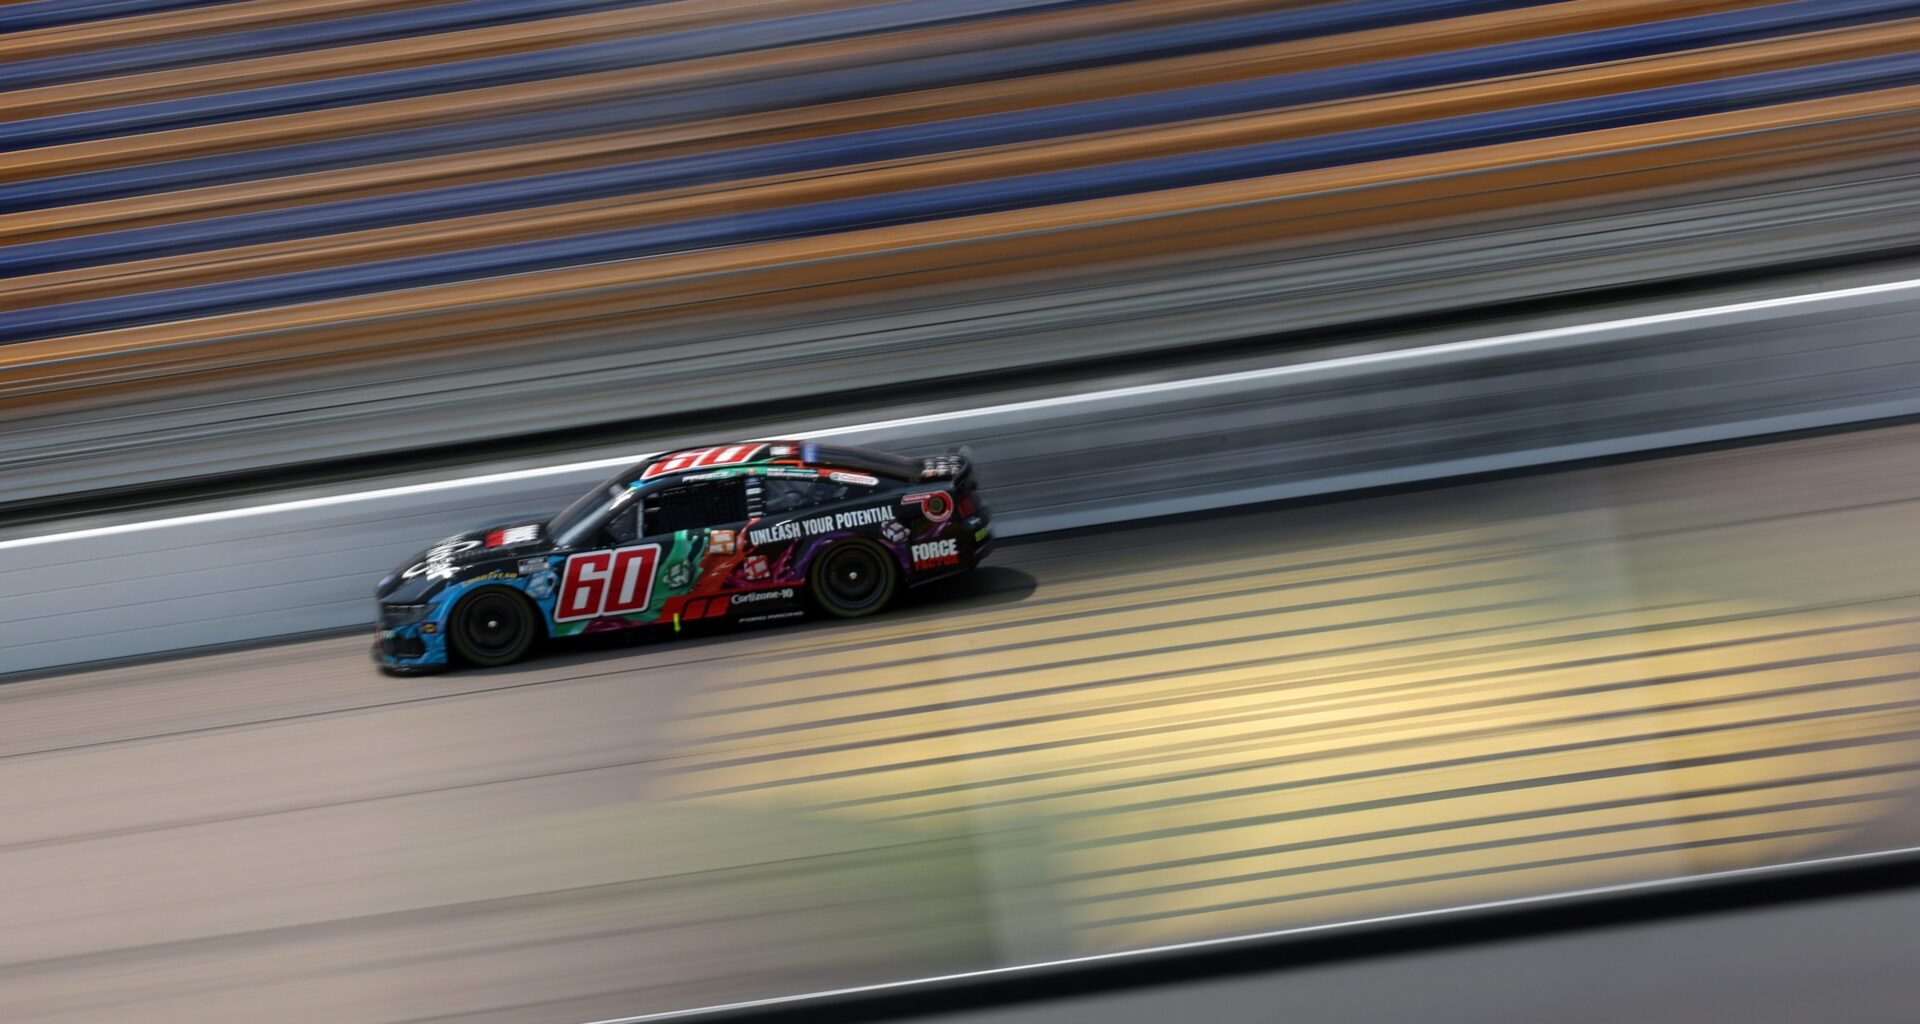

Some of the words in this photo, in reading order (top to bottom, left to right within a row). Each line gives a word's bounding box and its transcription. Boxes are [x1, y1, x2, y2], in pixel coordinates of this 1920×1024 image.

[641, 443, 769, 480] 60
[750, 523, 801, 546] UNLEASH
[803, 515, 834, 536] YOUR
[837, 505, 896, 529] POTENTIAL
[911, 538, 959, 562] FORCE
[554, 544, 661, 623] 60
